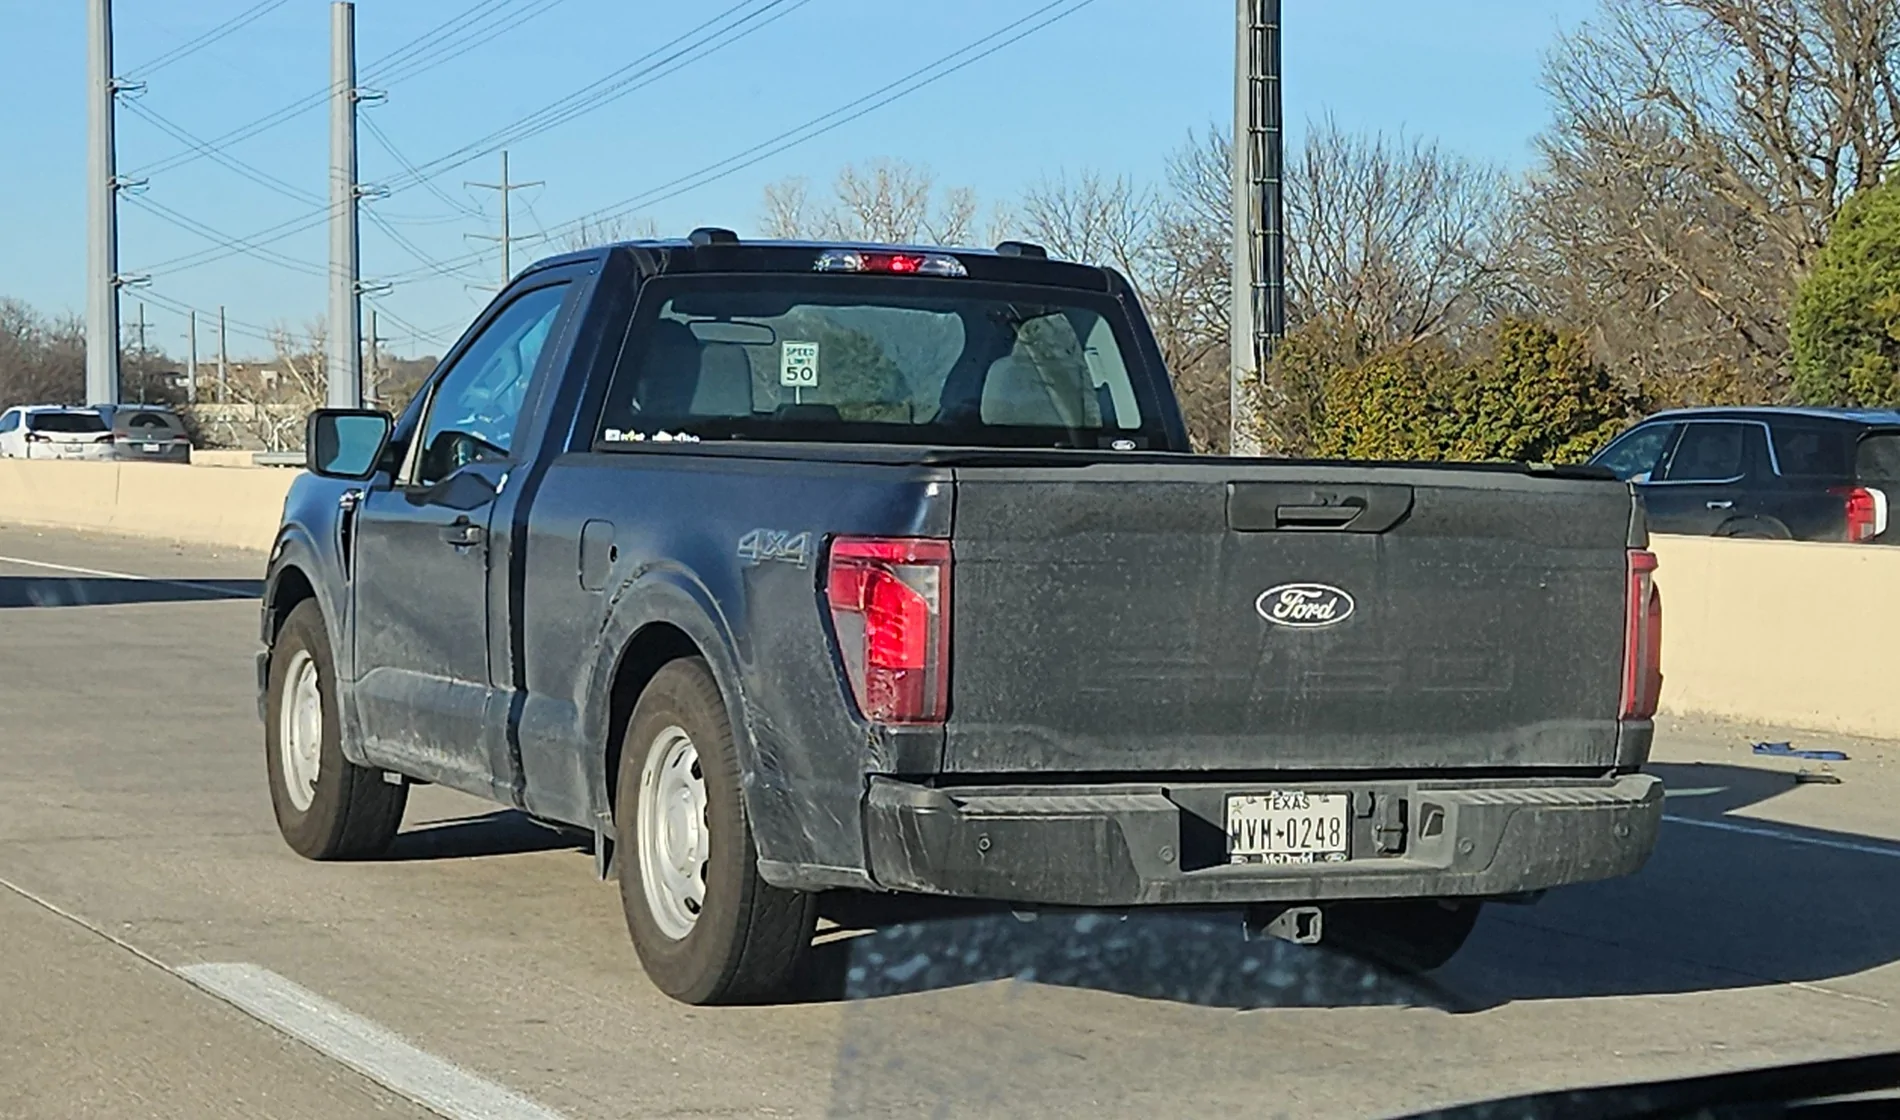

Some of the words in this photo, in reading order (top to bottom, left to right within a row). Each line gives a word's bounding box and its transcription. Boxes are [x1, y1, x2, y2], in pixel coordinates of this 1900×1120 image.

[786, 347, 815, 357] SPEED
[786, 366, 813, 381] 50
[1273, 589, 1338, 619] Ford
[1263, 797, 1311, 811] TEXAS
